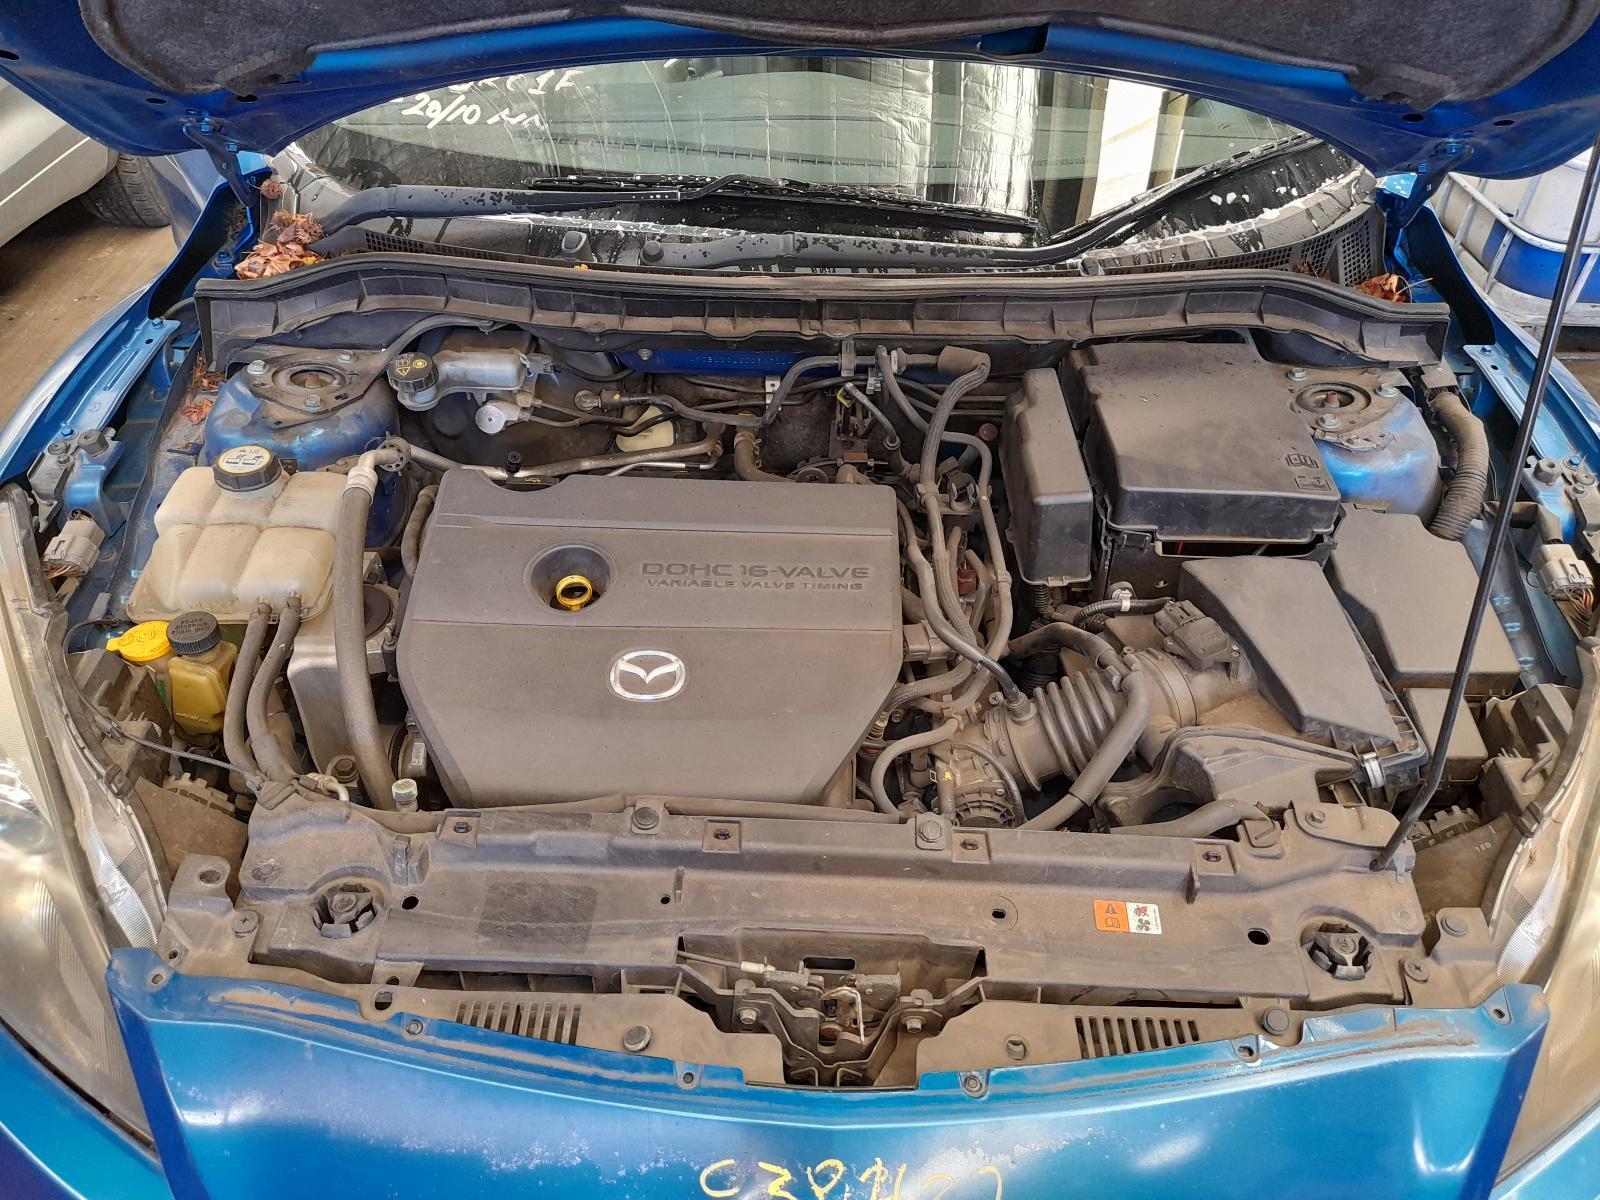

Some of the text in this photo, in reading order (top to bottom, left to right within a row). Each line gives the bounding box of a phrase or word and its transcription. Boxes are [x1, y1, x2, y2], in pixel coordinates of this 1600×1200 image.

[641, 562, 870, 579] DOHC 16-VALVE
[647, 579, 863, 591] VARIABLE VALVE TIMING
